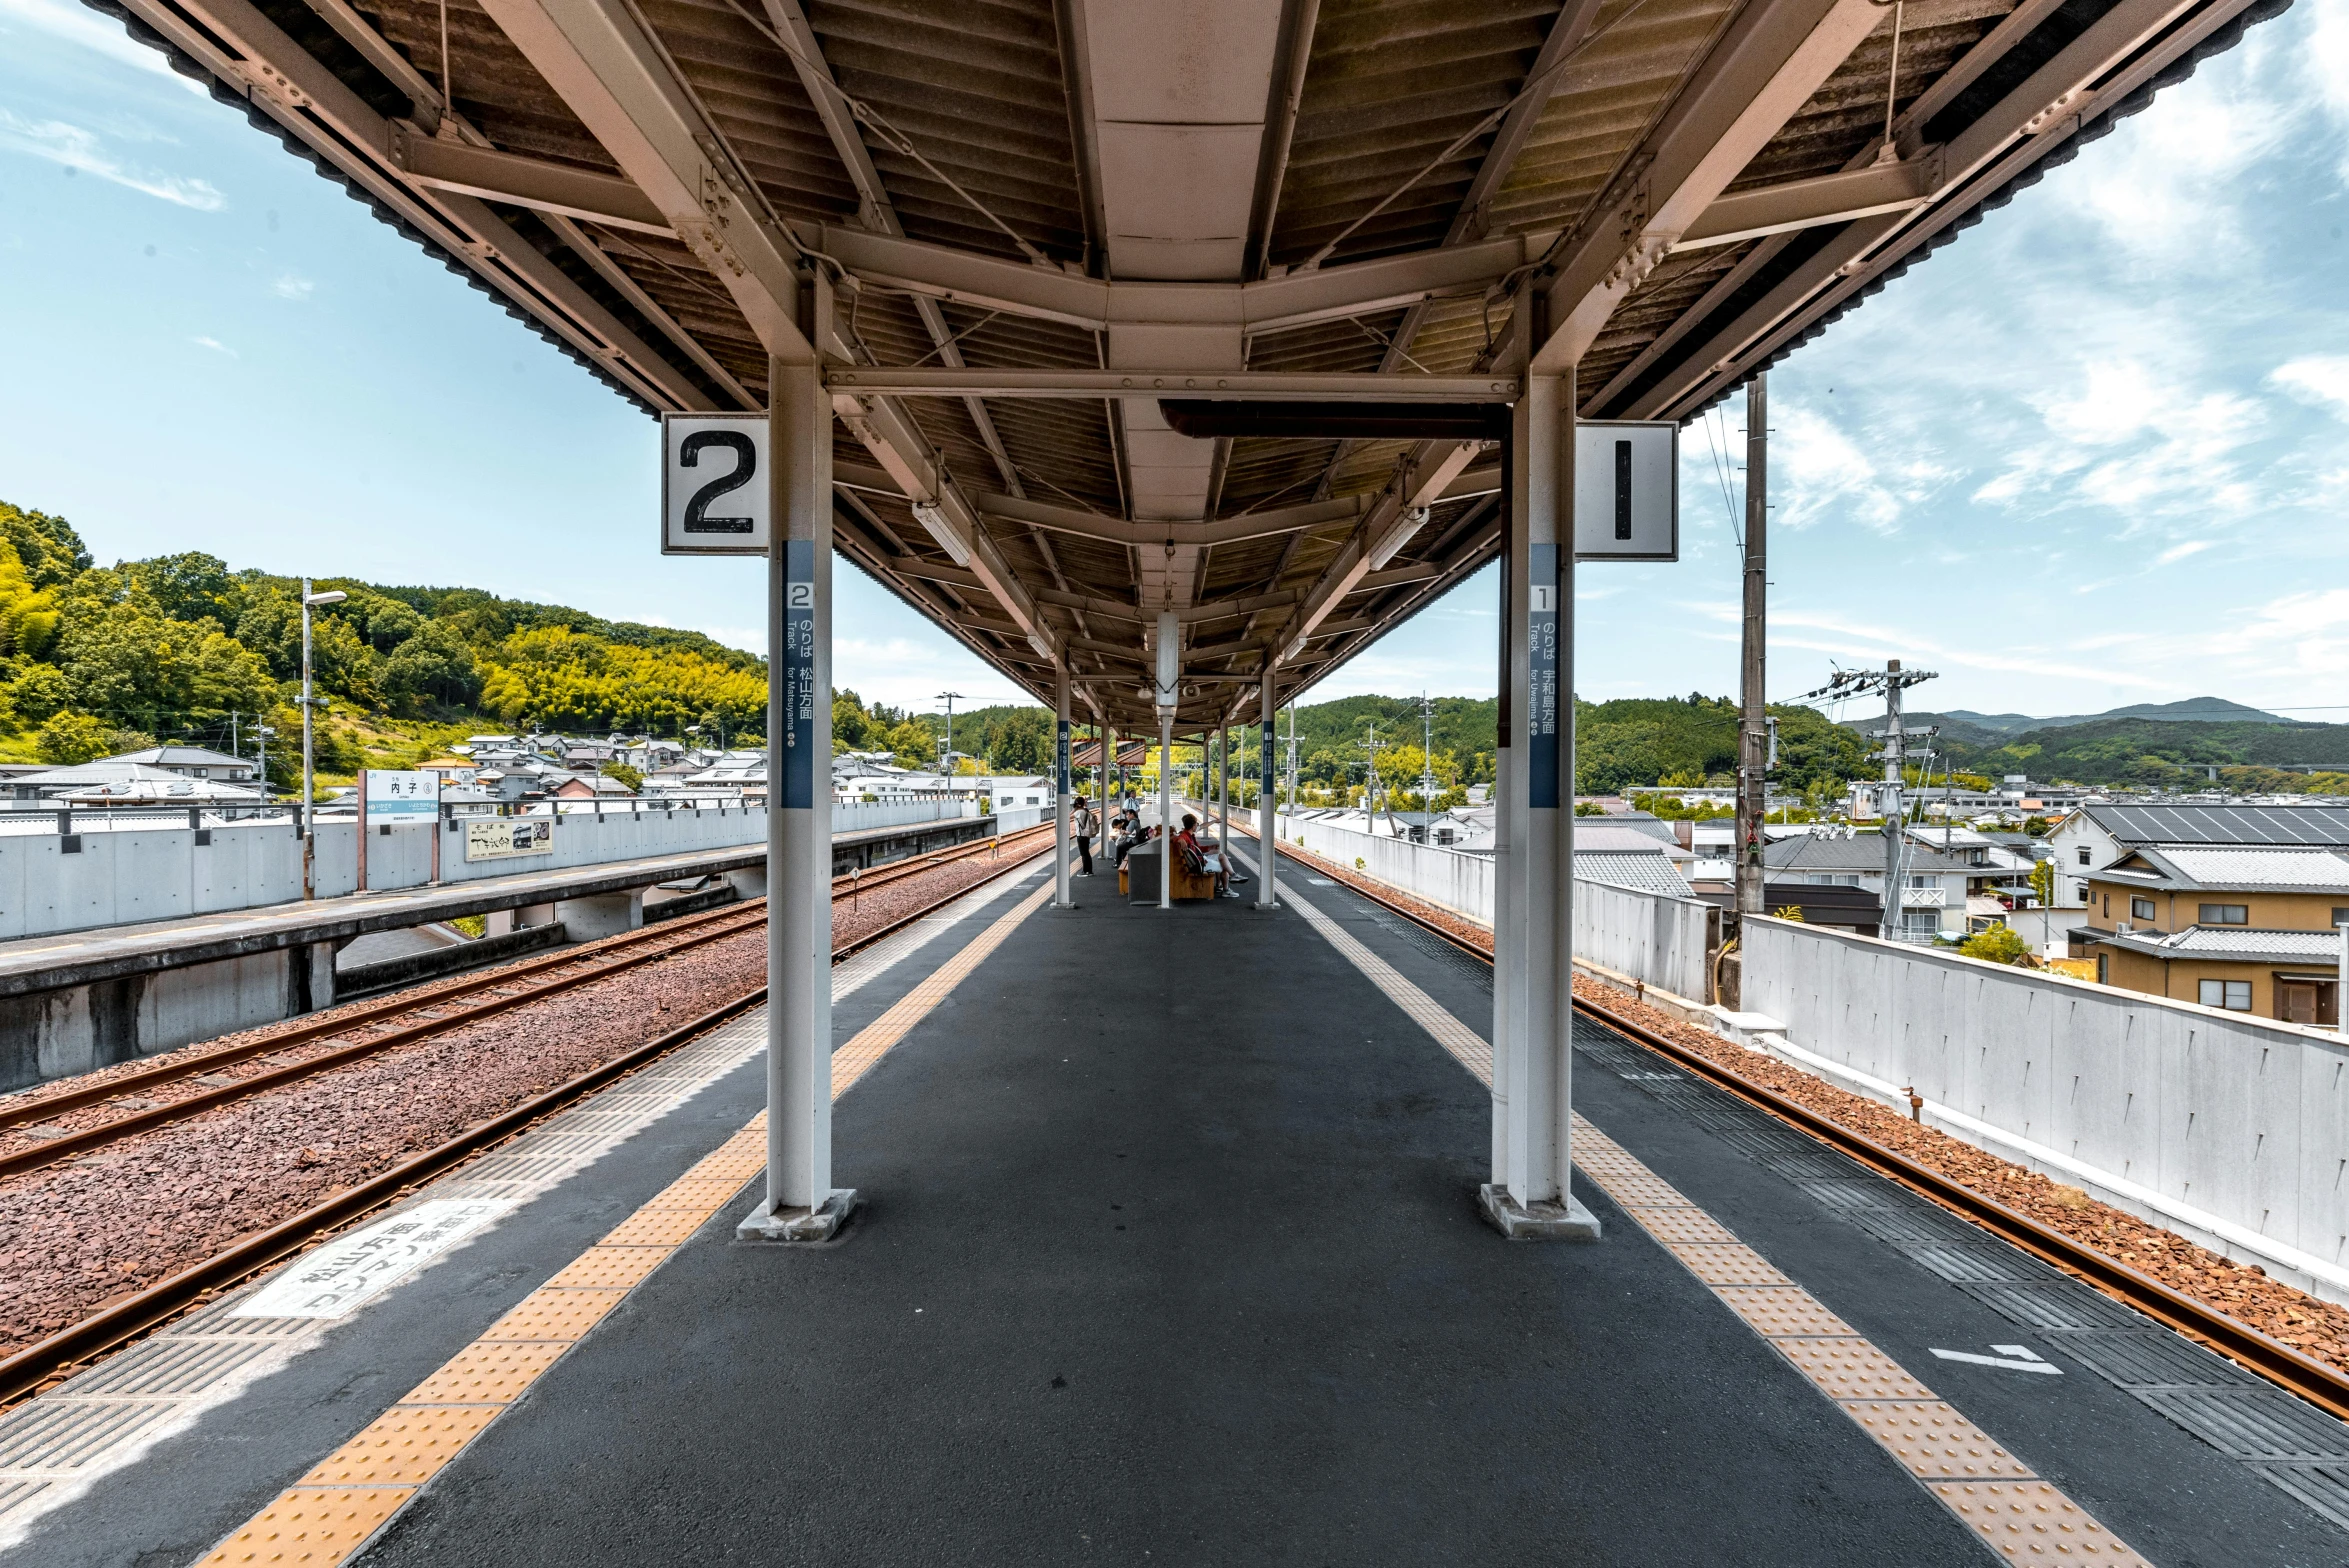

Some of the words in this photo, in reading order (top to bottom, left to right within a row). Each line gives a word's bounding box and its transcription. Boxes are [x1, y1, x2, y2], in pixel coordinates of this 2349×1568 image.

[680, 430, 757, 533] 2
[1615, 440, 1632, 540] 1
[791, 585, 810, 607] 2
[1538, 588, 1547, 609] 1
[787, 621, 797, 650] Track
[800, 619, 813, 658] のりば
[1530, 623, 1541, 652] Track
[1543, 622, 1556, 660] のりば
[787, 667, 796, 679] for
[1530, 669, 1539, 681] for
[786, 681, 796, 731] Matsuyama
[799, 667, 814, 720] 松山方面
[1530, 683, 1539, 719] Uwajima
[1542, 669, 1556, 735] 宇和島方面
[299, 1222, 425, 1284] 松山方面
